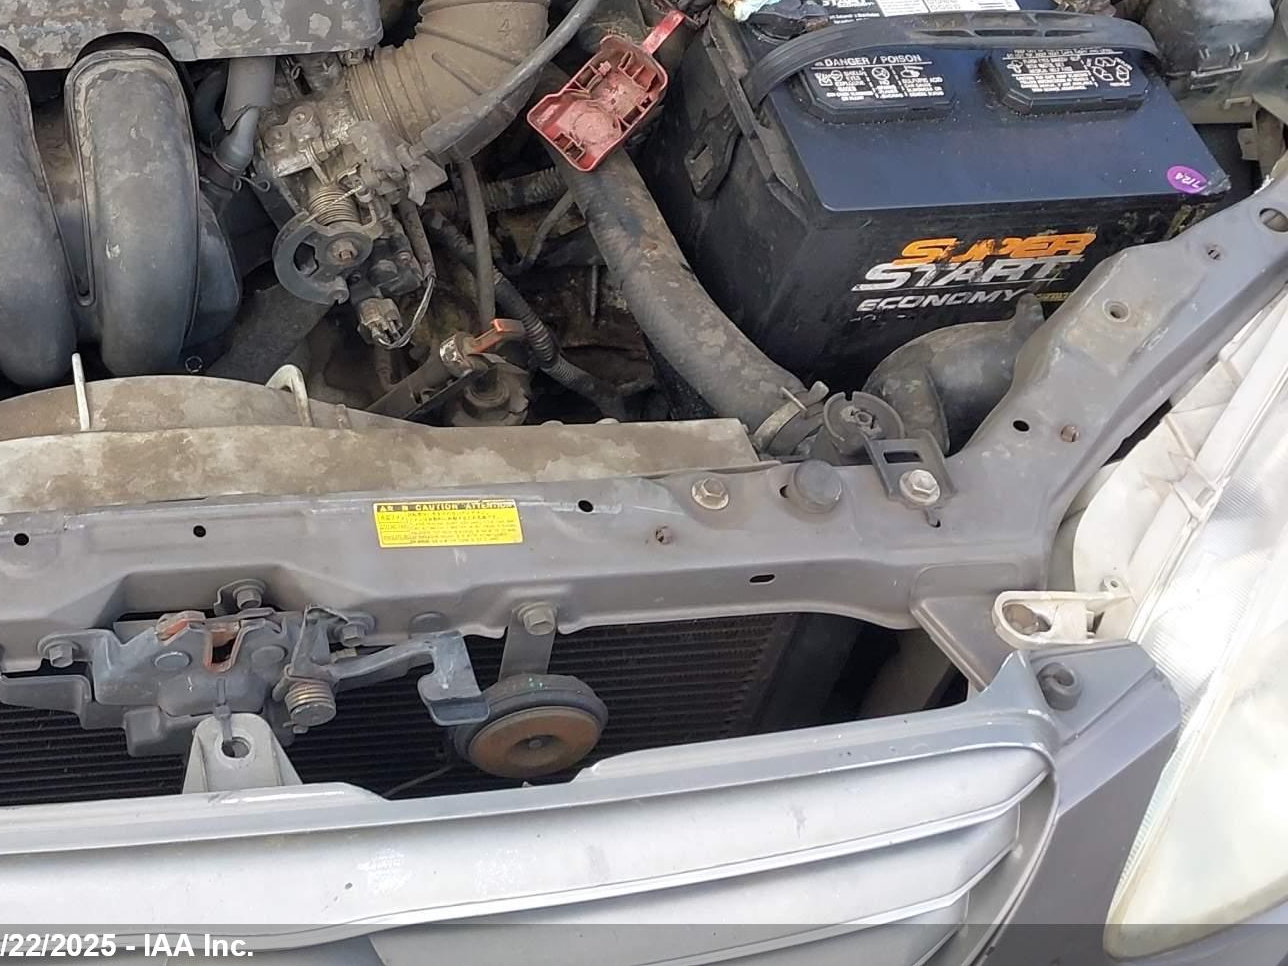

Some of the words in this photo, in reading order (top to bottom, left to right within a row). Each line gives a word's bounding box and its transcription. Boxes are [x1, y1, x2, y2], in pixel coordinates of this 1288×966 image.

[824, 56, 871, 67] DANGER
[879, 54, 922, 64] POISON
[851, 253, 1085, 291] START
[856, 288, 1028, 313] ECONOMY
[415, 504, 459, 512] CAUTION
